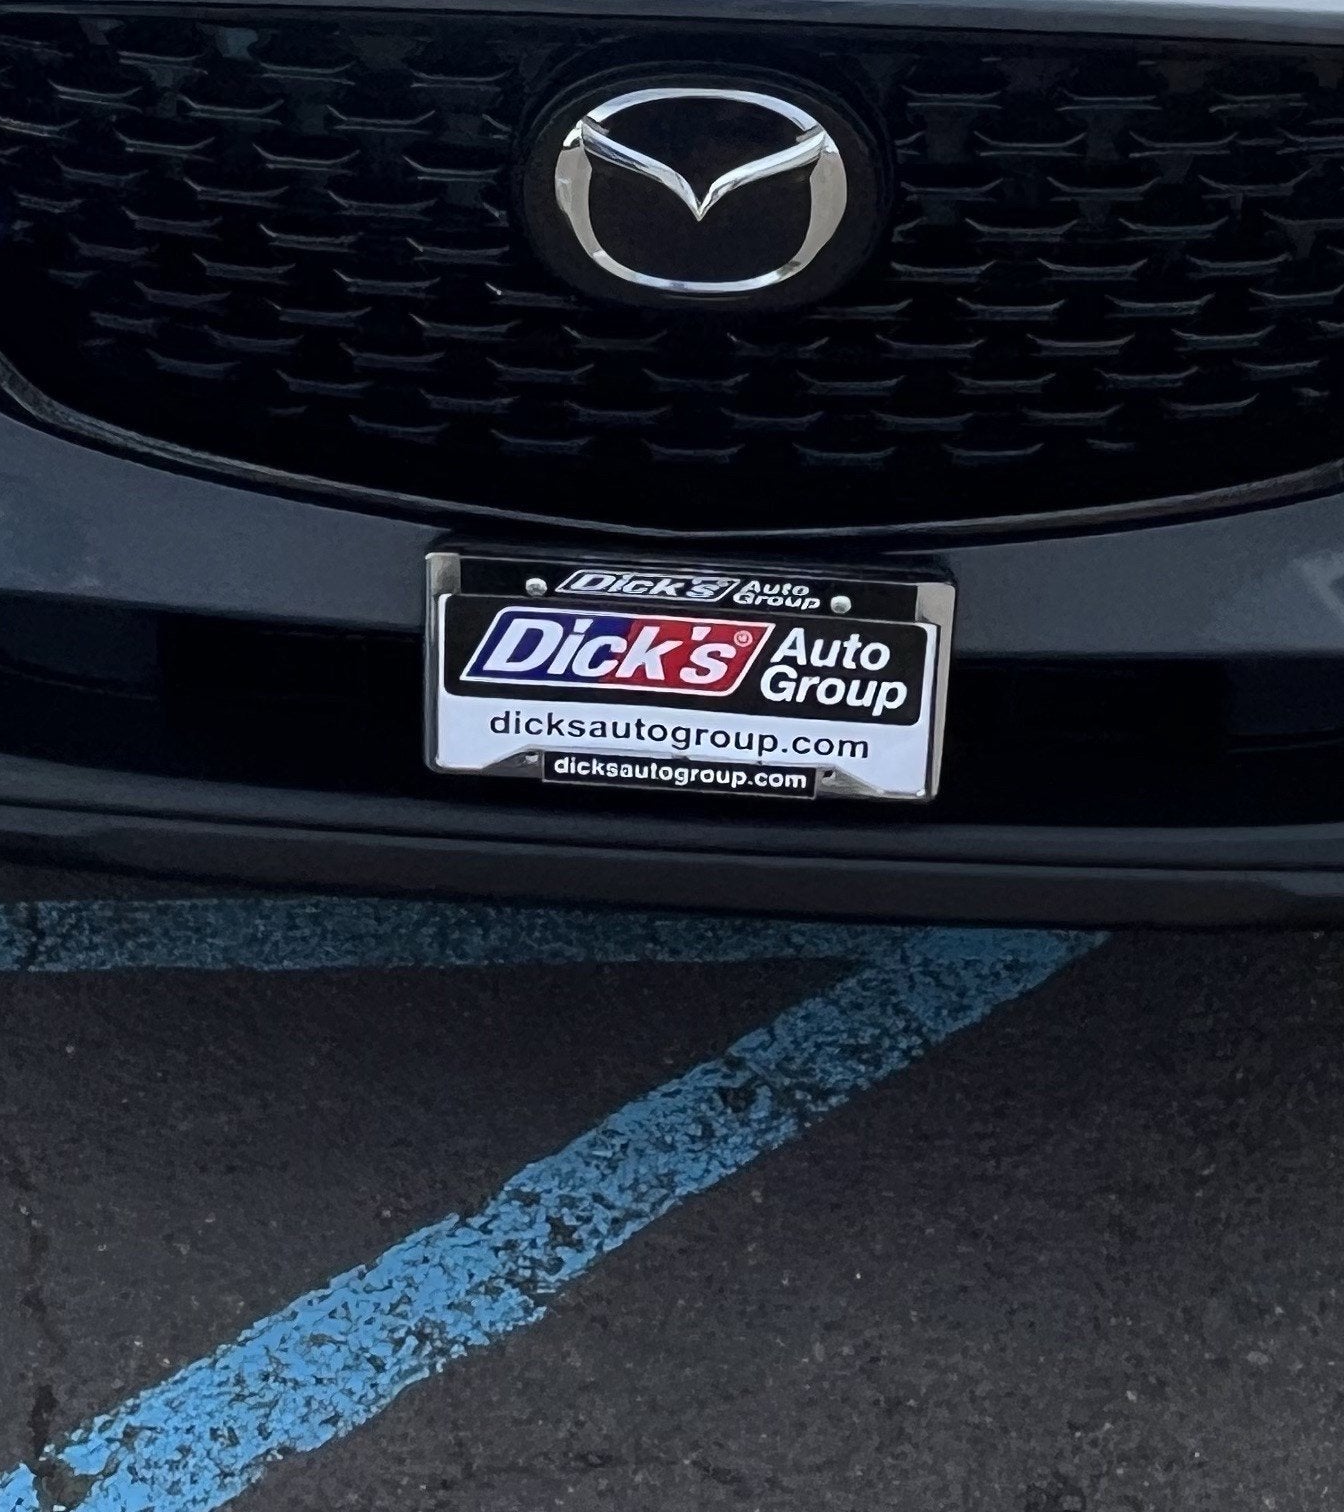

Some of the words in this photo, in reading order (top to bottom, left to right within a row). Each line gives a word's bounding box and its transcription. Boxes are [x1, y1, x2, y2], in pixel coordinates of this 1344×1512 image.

[733, 591, 821, 610] Group
[739, 580, 810, 596] Auto
[483, 618, 737, 684] Dick's
[770, 627, 891, 671] Auto
[760, 664, 908, 717] Group
[490, 710, 869, 759] dicksautogroup.com
[554, 755, 807, 790] dicksautogroup.com
